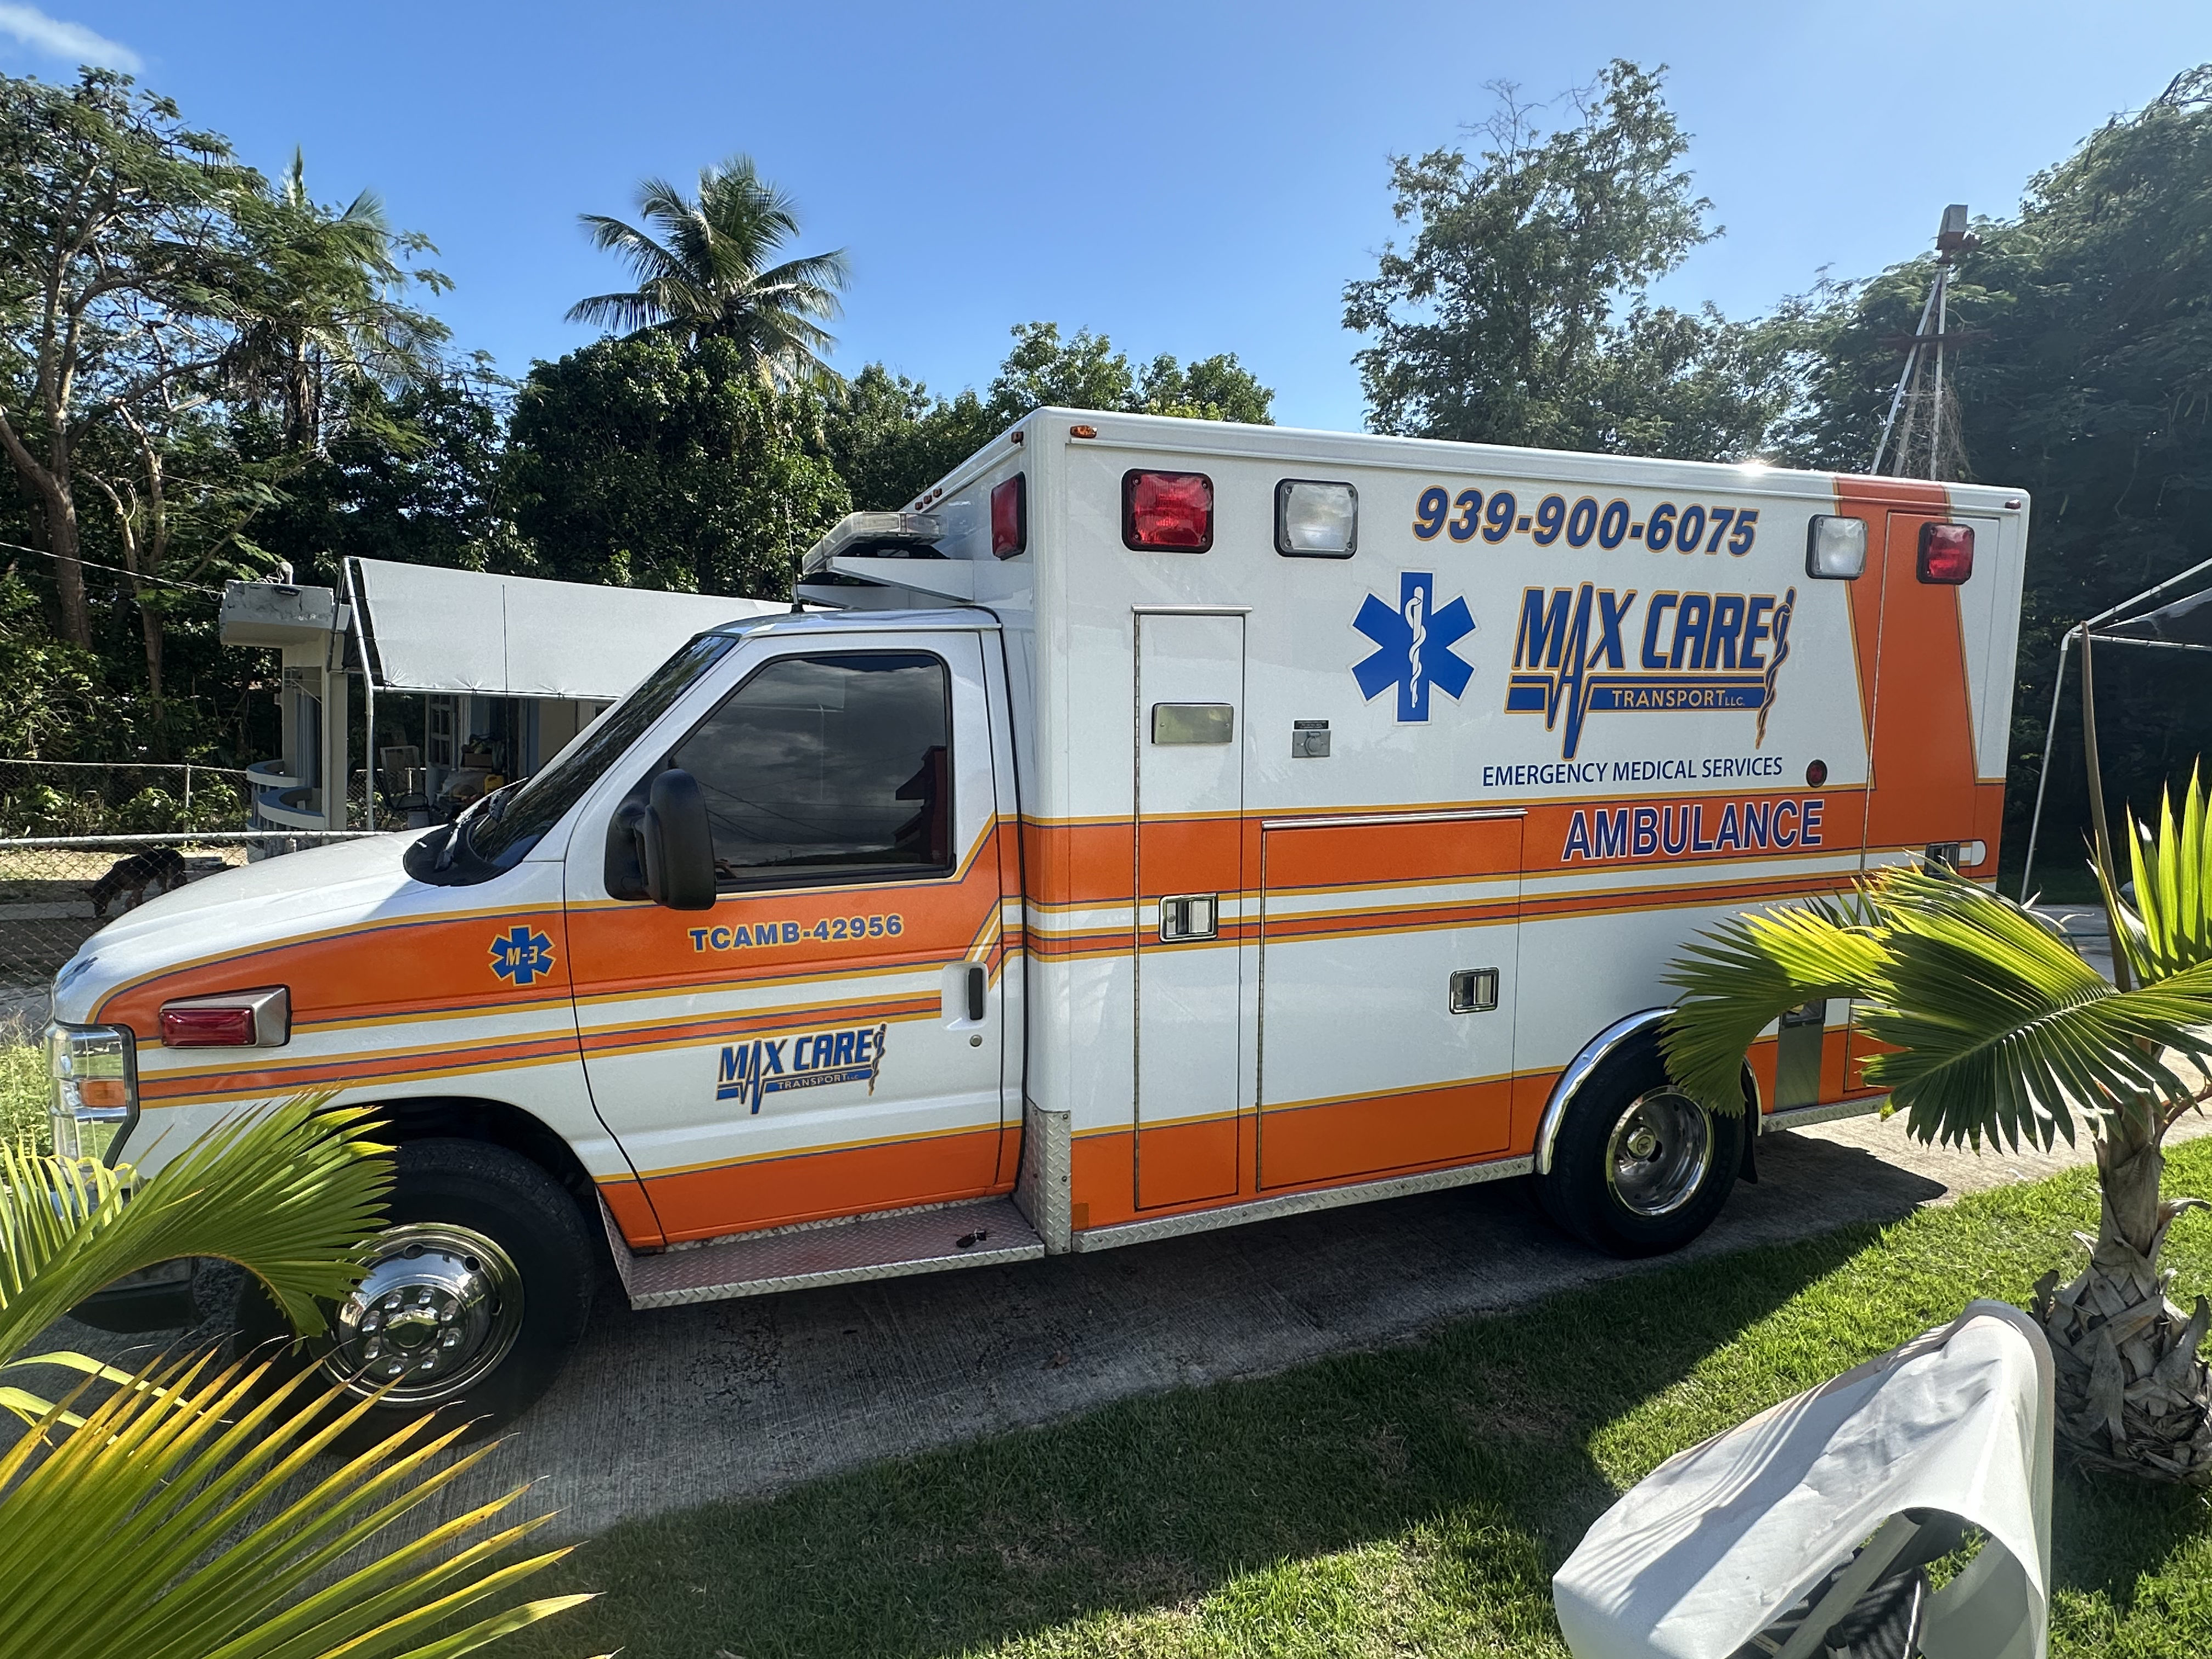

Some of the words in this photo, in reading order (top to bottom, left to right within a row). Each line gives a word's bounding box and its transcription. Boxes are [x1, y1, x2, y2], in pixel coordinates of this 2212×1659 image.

[1412, 485, 1760, 557] 939-900-6075
[1640, 589, 1777, 670] CARE
[1612, 690, 1725, 707] TRANSPORT
[1482, 761, 1607, 787] EMERGENCY
[1612, 758, 1697, 781] MEDICAL
[1702, 757, 1782, 778] SERVICES
[1561, 799, 1825, 862] AMBULANCE
[688, 913, 905, 953] TCAMB-42956
[506, 946, 539, 966] M-3
[793, 1028, 874, 1071] CARE
[777, 1073, 849, 1090] TRANSPORT
